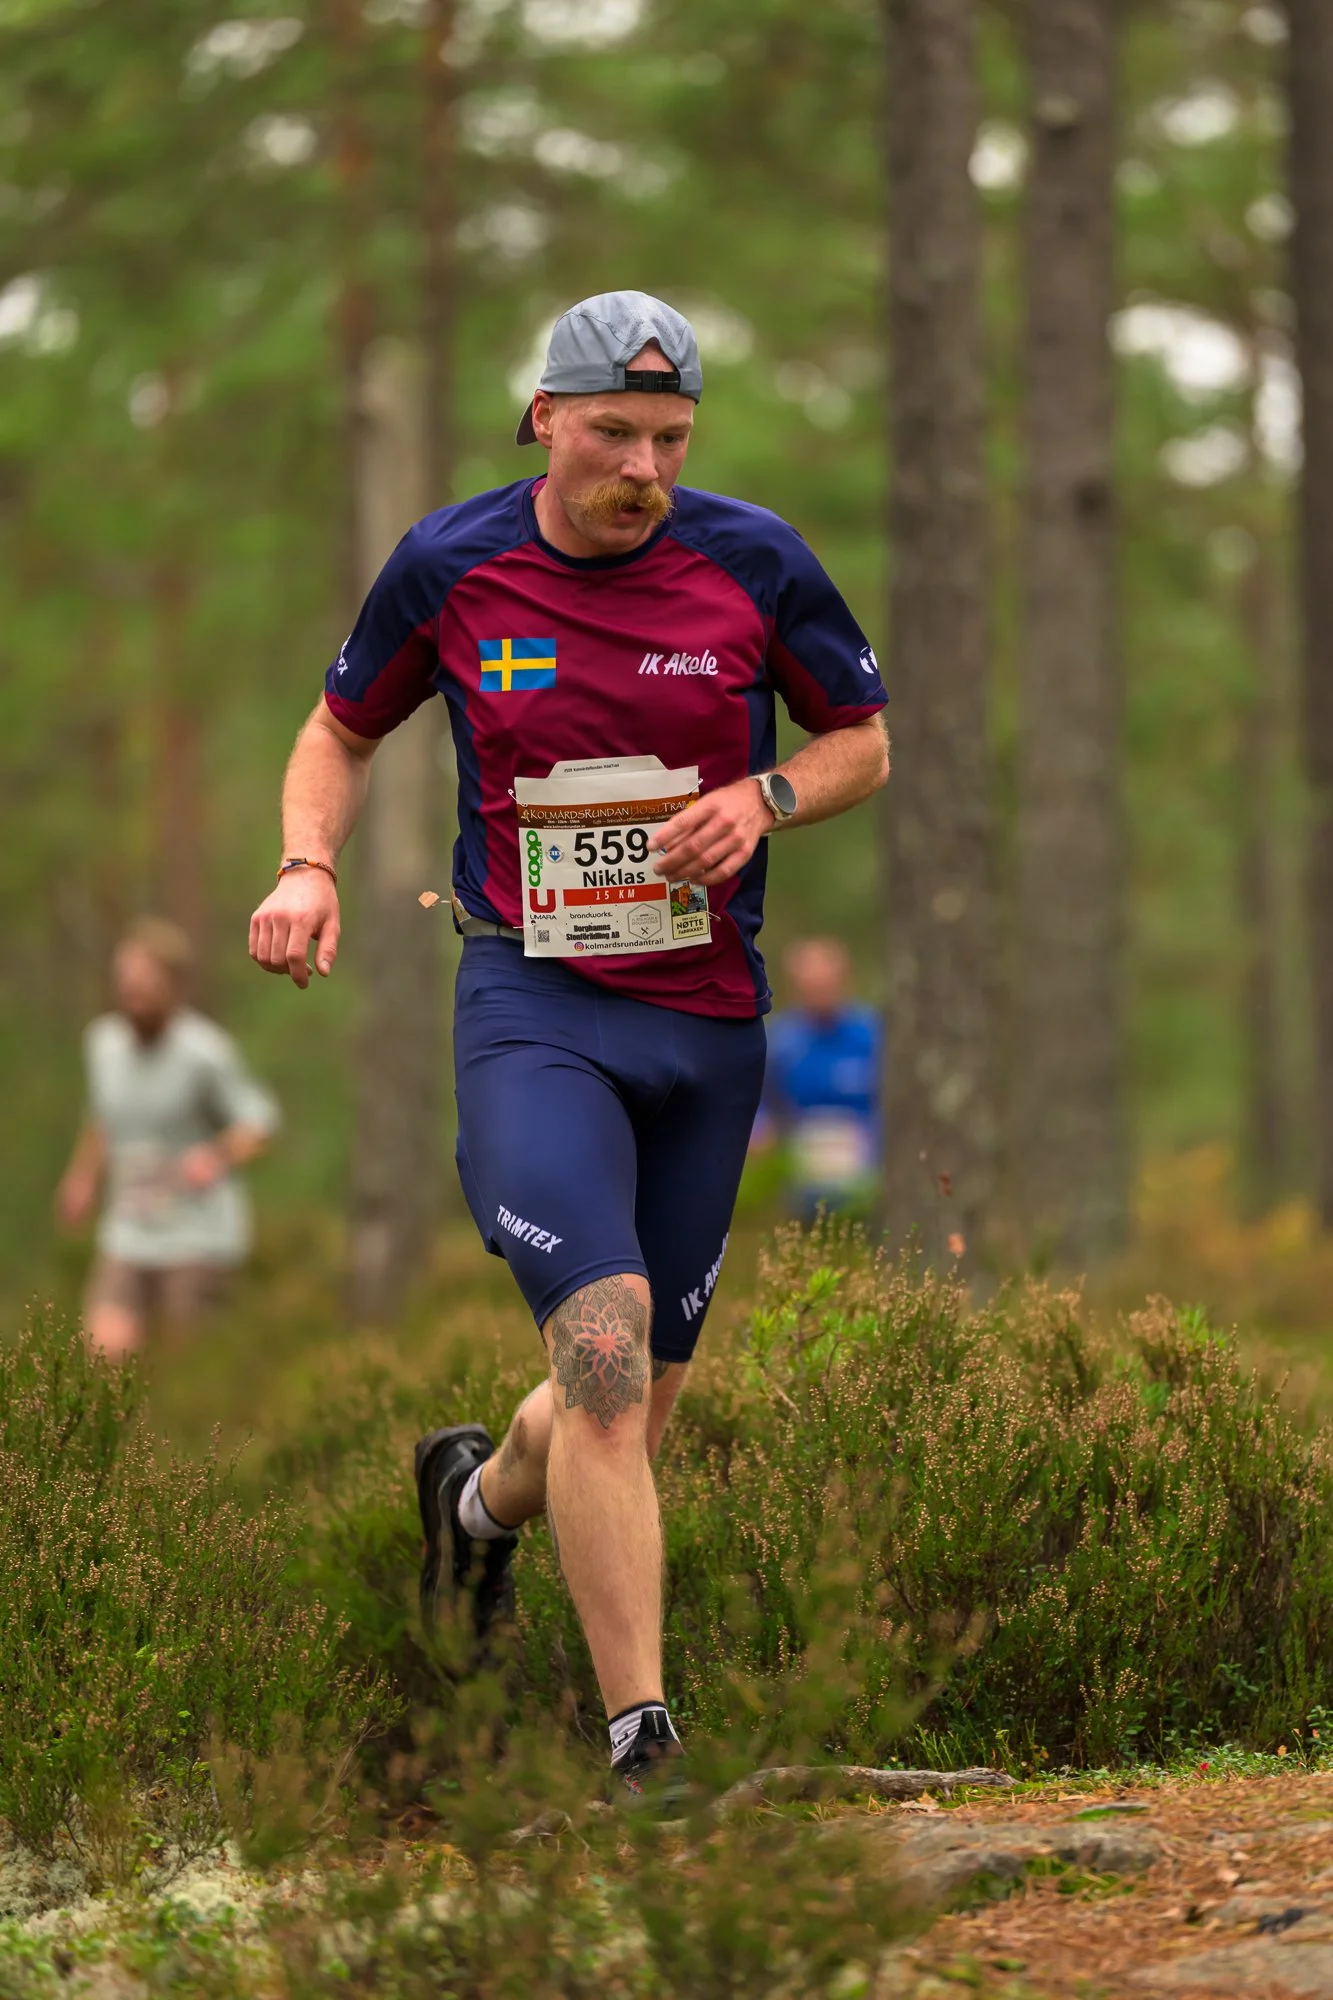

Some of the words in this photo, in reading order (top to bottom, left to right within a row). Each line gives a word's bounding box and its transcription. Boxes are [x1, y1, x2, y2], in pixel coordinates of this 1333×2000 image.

[637, 653, 664, 675] IK
[663, 649, 719, 676] Akele
[526, 830, 542, 887] coop
[574, 828, 650, 867] 559
[583, 869, 646, 887] Niklas
[596, 890, 610, 900] 15
[619, 888, 635, 899] KM
[611, 931, 620, 939] AB
[676, 918, 704, 930] NØTTE
[495, 1205, 563, 1254] TRIMTEX
[681, 1287, 704, 1321] IK
